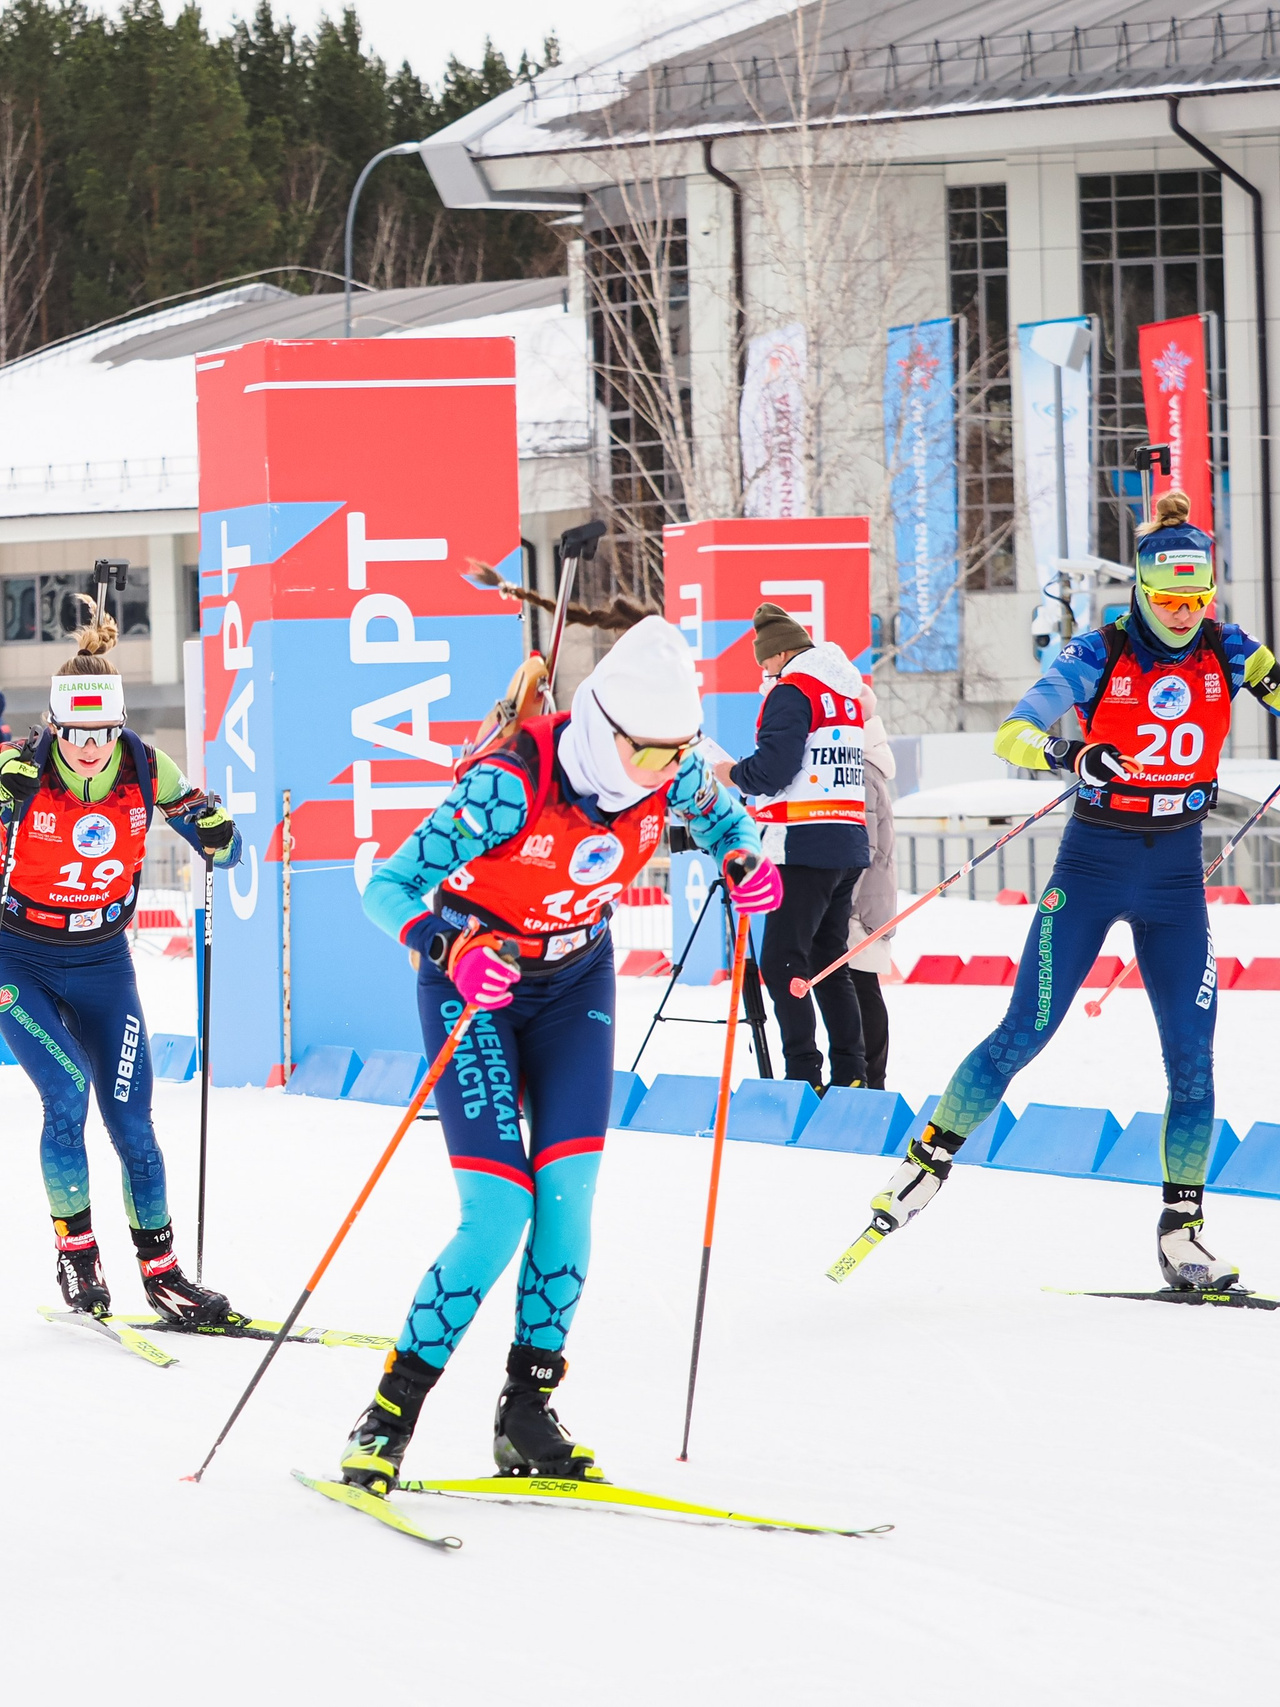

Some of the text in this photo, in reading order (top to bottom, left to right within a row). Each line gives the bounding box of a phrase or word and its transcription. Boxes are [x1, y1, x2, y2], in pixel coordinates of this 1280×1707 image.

[220, 519, 260, 920] СТАРТ
[1134, 722, 1204, 766] 20
[833, 767, 864, 788] ДЕЛЕГ
[1132, 771, 1195, 782] КРАСНОЯРСК
[53, 859, 124, 891] 19
[542, 883, 623, 922] 18
[1035, 916, 1053, 1031] БЕЛОРУСНЕФТЬ
[10, 1005, 86, 1092] БЕЛОРУСНЕФТЬ
[118, 1014, 141, 1079] BEEU
[474, 1008, 520, 1141] МЕНСКАЯ
[1177, 1190, 1197, 1198] 170
[154, 1230, 171, 1243] 169
[1202, 1294, 1230, 1302] FISCHER
[197, 1326, 226, 1334] FISCHER
[342, 1334, 397, 1346] FISCH
[530, 1365, 553, 1380] 168
[529, 1481, 578, 1492] FISCHER
